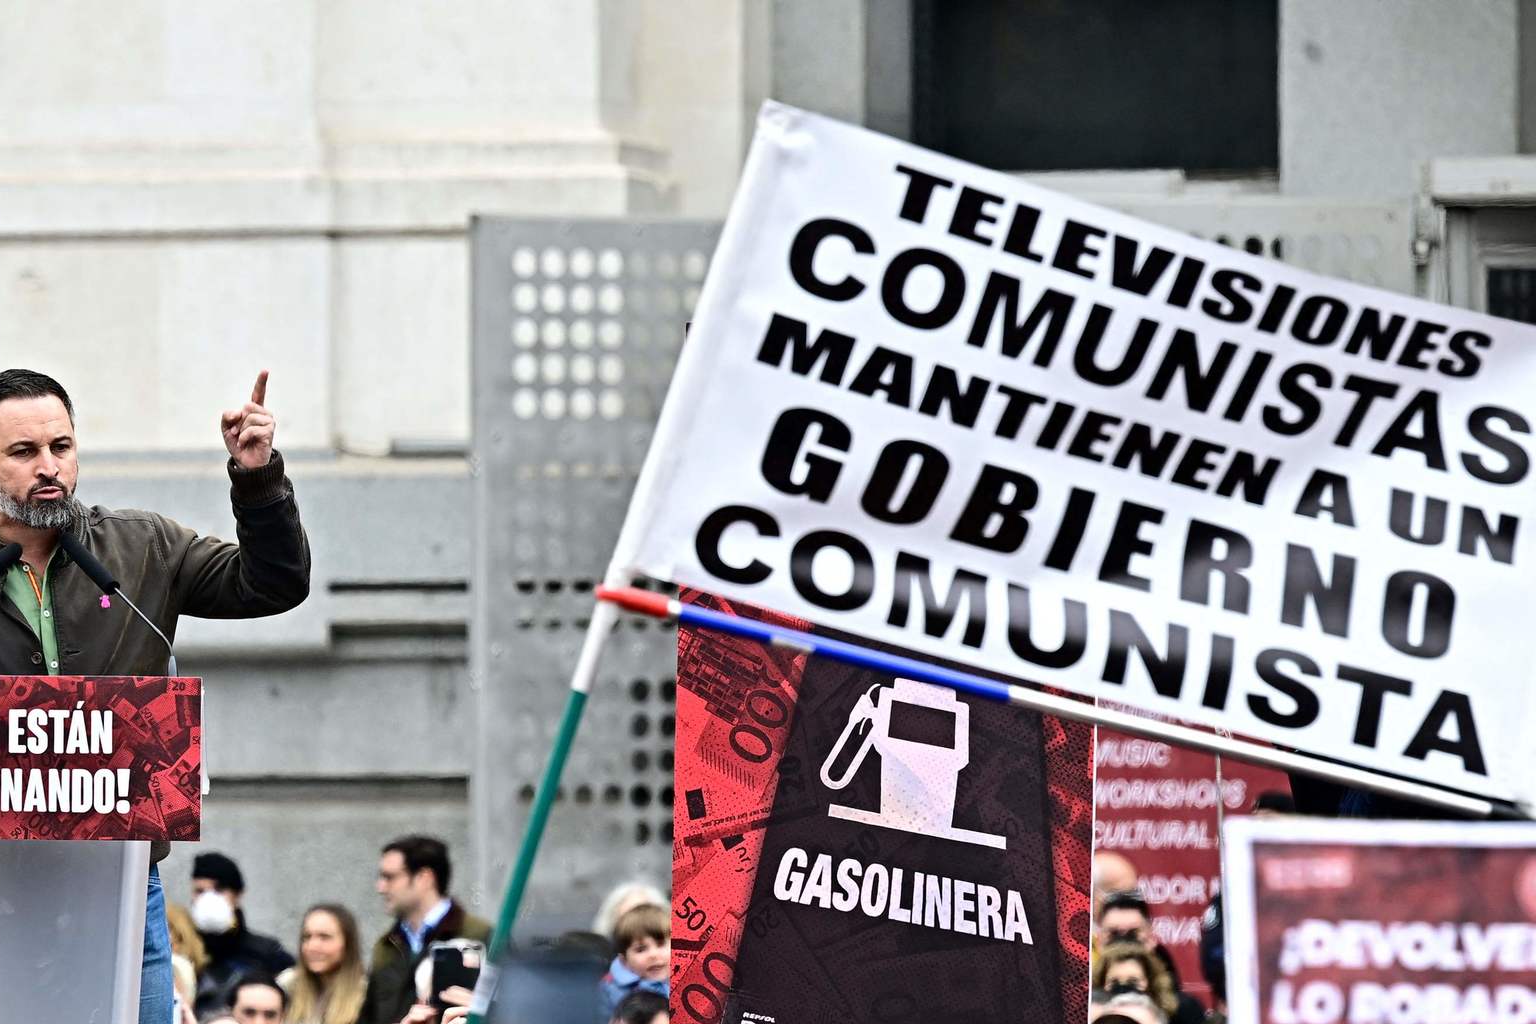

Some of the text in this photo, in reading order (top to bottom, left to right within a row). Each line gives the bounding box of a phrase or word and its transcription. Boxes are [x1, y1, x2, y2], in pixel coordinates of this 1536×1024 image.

[788, 216, 1533, 486] COMUNISTAS
[895, 163, 1492, 379] TELEVISIONES
[755, 312, 1520, 565] MANTIENEN A UN
[760, 406, 1457, 659] GOBIERNO
[8, 700, 113, 755] ESTÁN
[694, 504, 1489, 777] COMUNISTA
[675, 896, 707, 931] 50
[773, 847, 1034, 945] GASOLINERA
[742, 1011, 776, 1023] REPSOL
